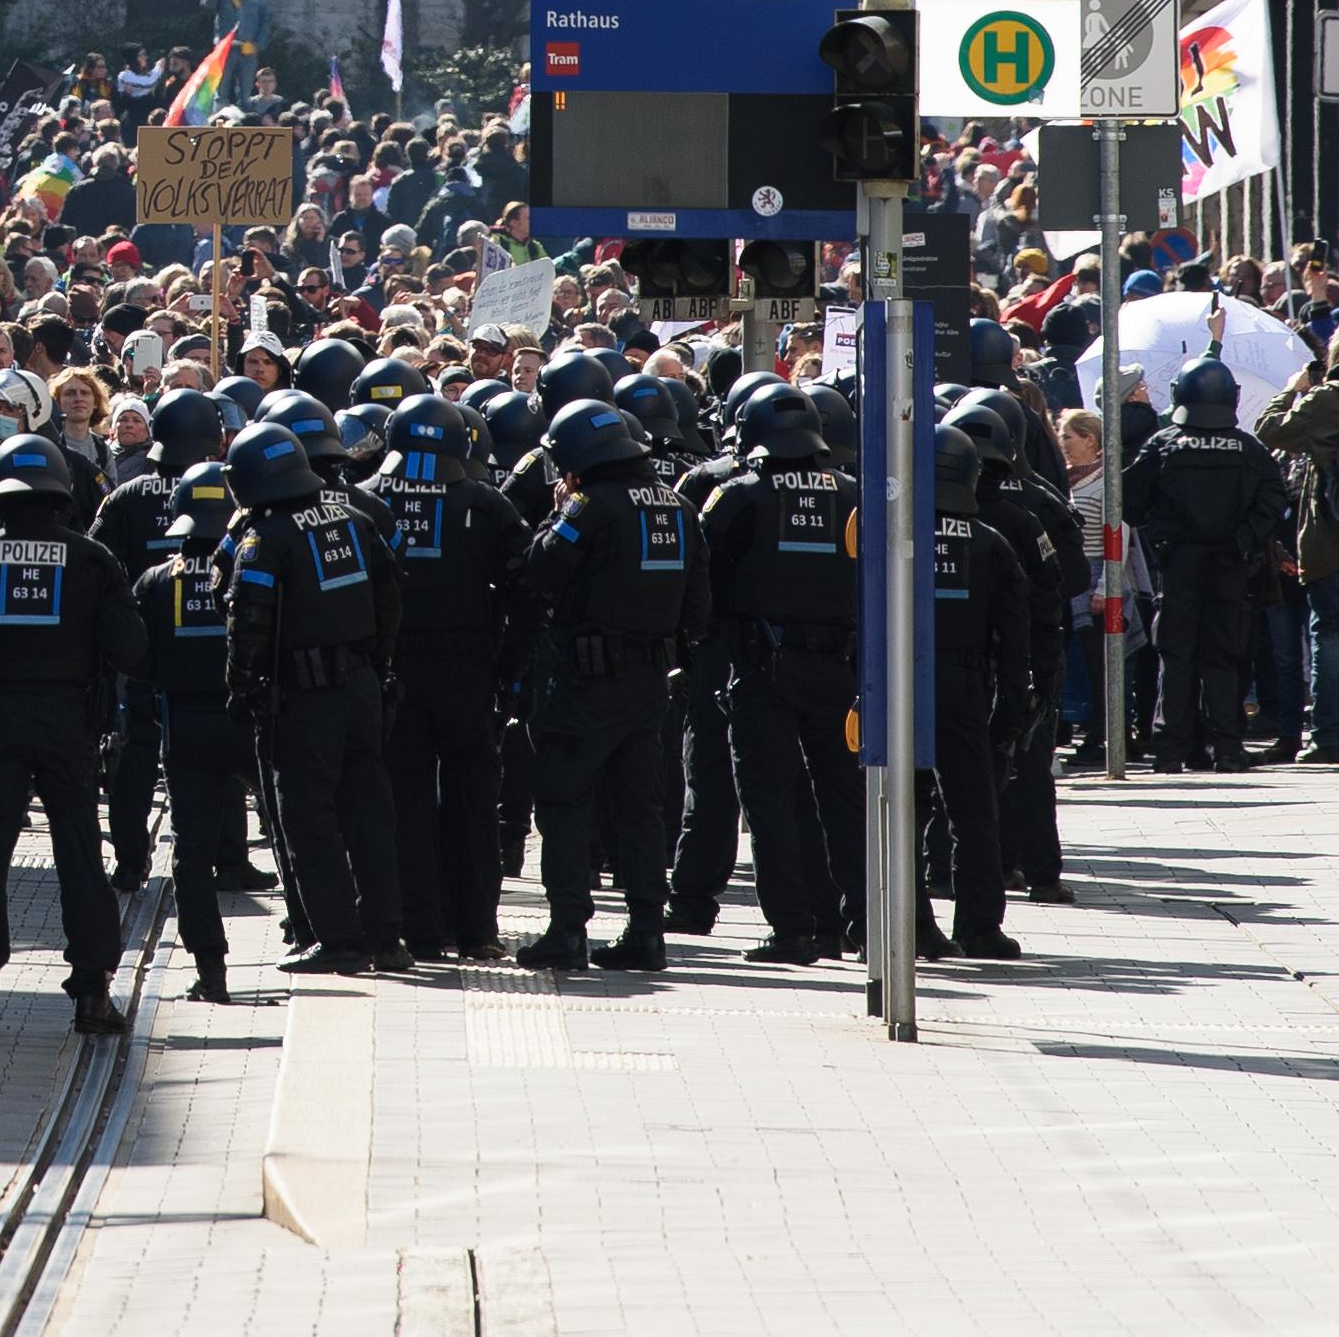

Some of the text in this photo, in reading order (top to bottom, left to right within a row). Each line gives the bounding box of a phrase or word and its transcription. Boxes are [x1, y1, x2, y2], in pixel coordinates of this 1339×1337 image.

[546, 10, 620, 29] Rathaus
[548, 53, 579, 65] Tram
[983, 31, 1030, 83] H
[165, 131, 285, 164] STOPPT
[200, 159, 260, 180] DEN
[141, 176, 292, 220] VOLKSVERRAT
[1159, 188, 1174, 198] KS
[689, 298, 717, 318] ABF
[769, 300, 800, 319] ABF
[1179, 436, 1242, 452] POLIZEI
[772, 471, 838, 491] POLIZEI
[629, 487, 681, 506] POLIZEI
[799, 497, 815, 508] HE
[405, 501, 421, 512] HE
[292, 504, 350, 531] POLIZEI
[396, 520, 428, 531] 63 14
[656, 514, 668, 525] HE
[792, 514, 824, 527] 63 11
[326, 529, 340, 543] HE
[652, 533, 676, 544] 63 14
[2, 543, 63, 563] POLIZEI
[325, 545, 352, 563] 63 14
[23, 568, 40, 580] HE
[13, 587, 47, 599] 63 14
[187, 600, 201, 610] 63
